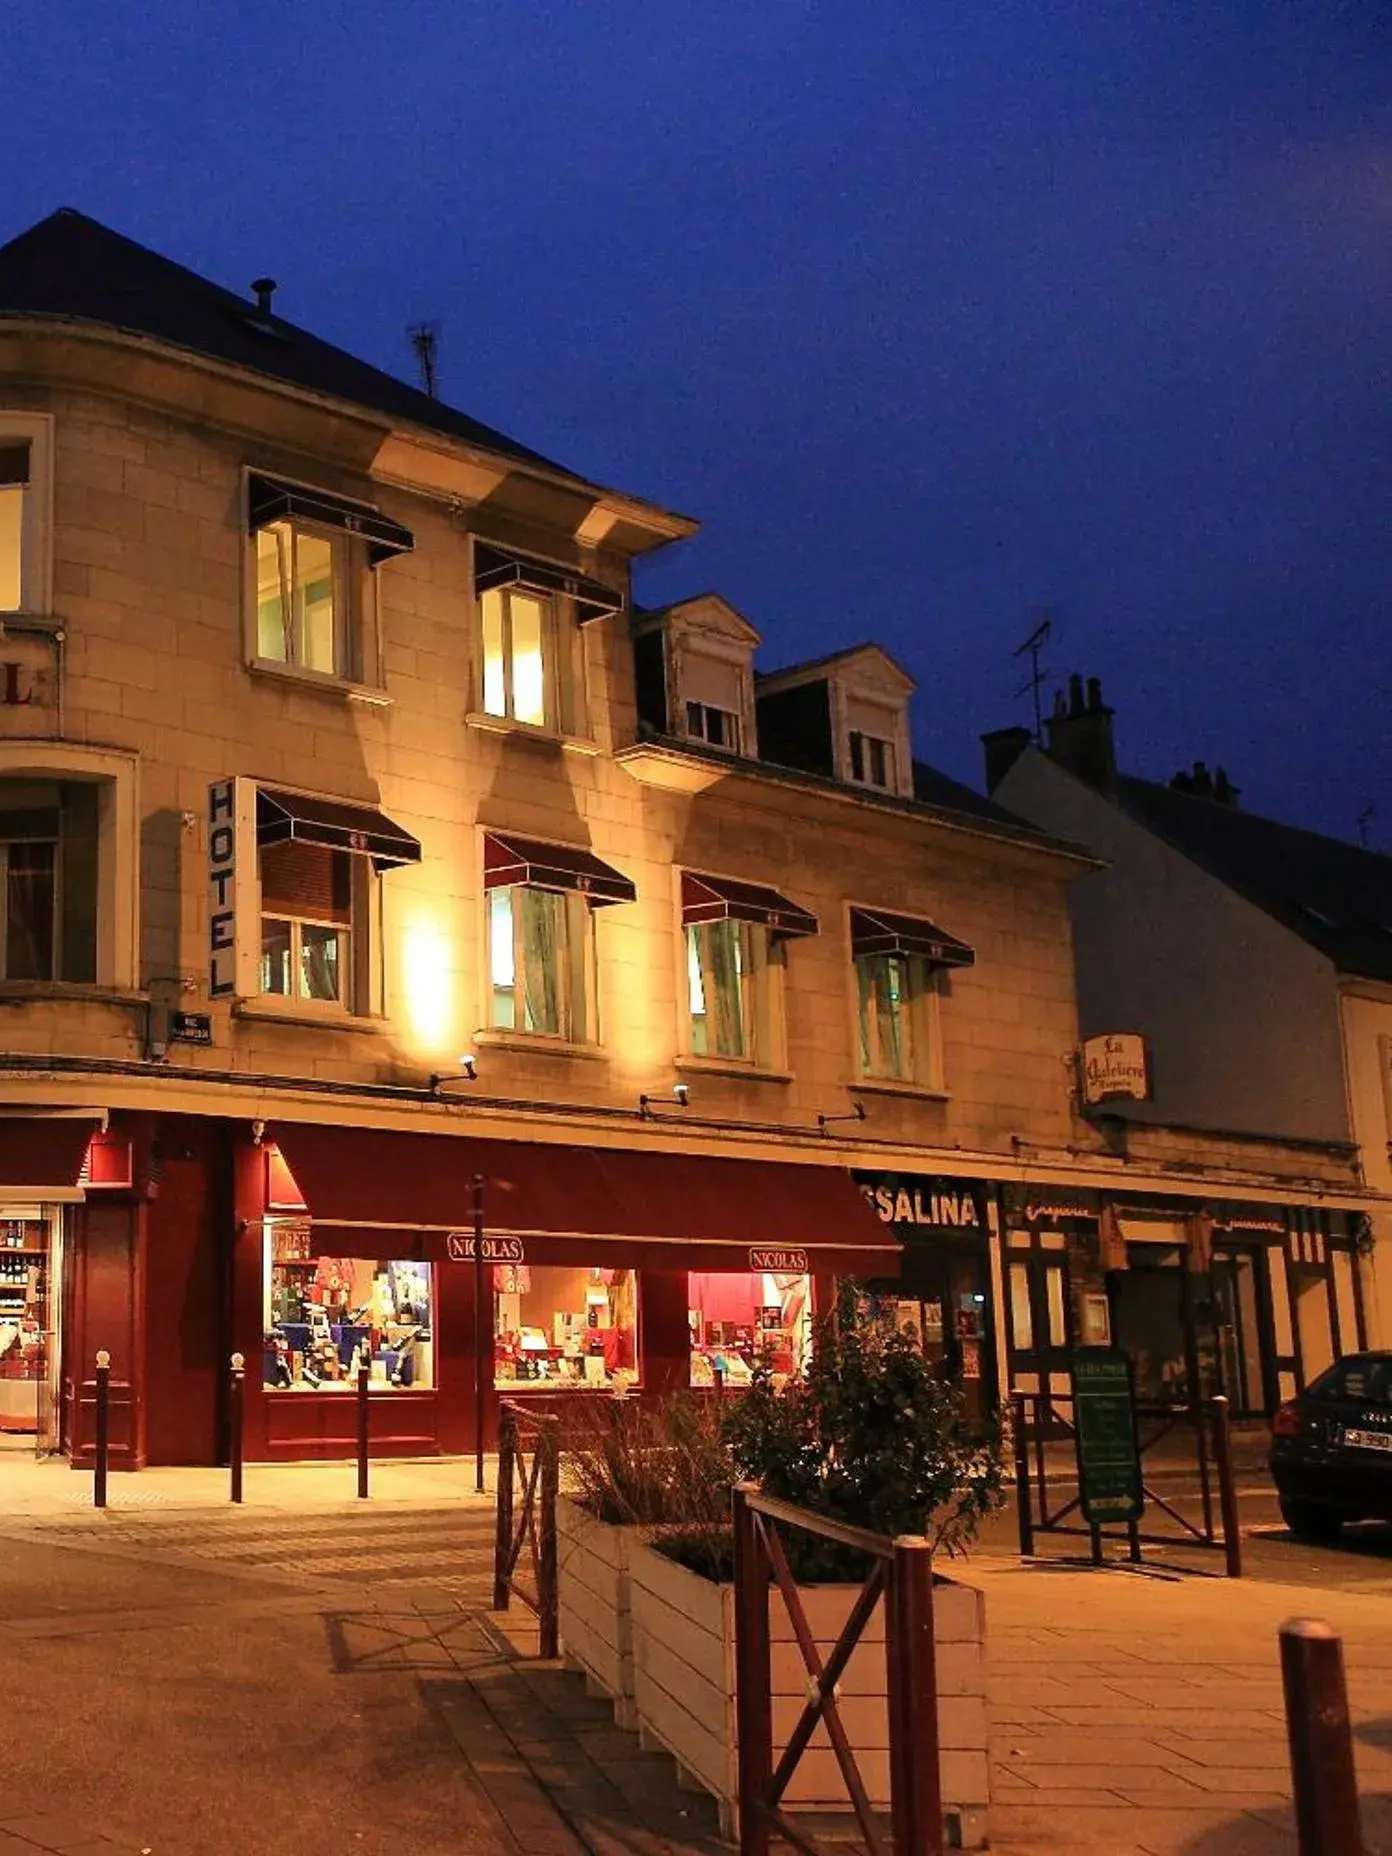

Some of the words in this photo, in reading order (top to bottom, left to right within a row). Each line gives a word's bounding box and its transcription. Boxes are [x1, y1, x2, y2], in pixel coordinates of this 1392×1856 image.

[210, 782, 234, 995] HOTEL
[452, 1238, 520, 1258] NICOLAS
[752, 1252, 805, 1269] NICOLAS
